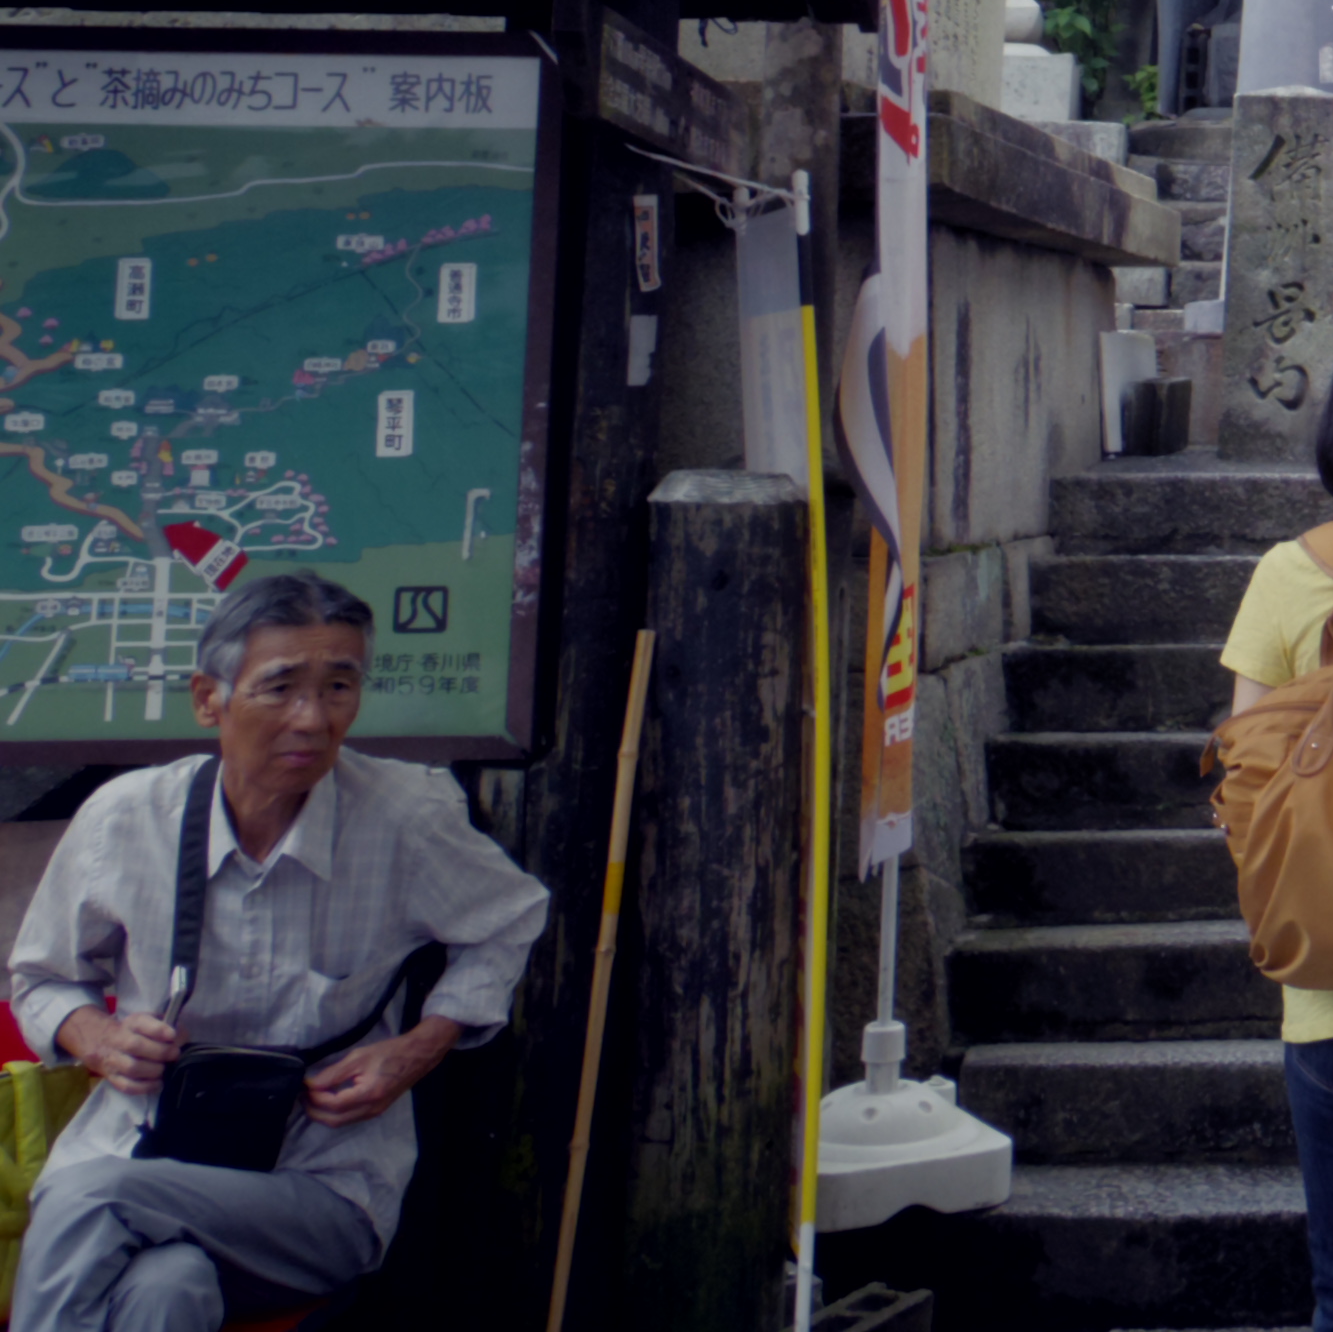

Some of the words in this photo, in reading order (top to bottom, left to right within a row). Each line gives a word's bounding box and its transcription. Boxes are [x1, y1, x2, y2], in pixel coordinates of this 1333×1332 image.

[388, 72, 496, 115] 案内板
[445, 268, 466, 320] 善通寺市
[384, 396, 405, 452] 琴平町
